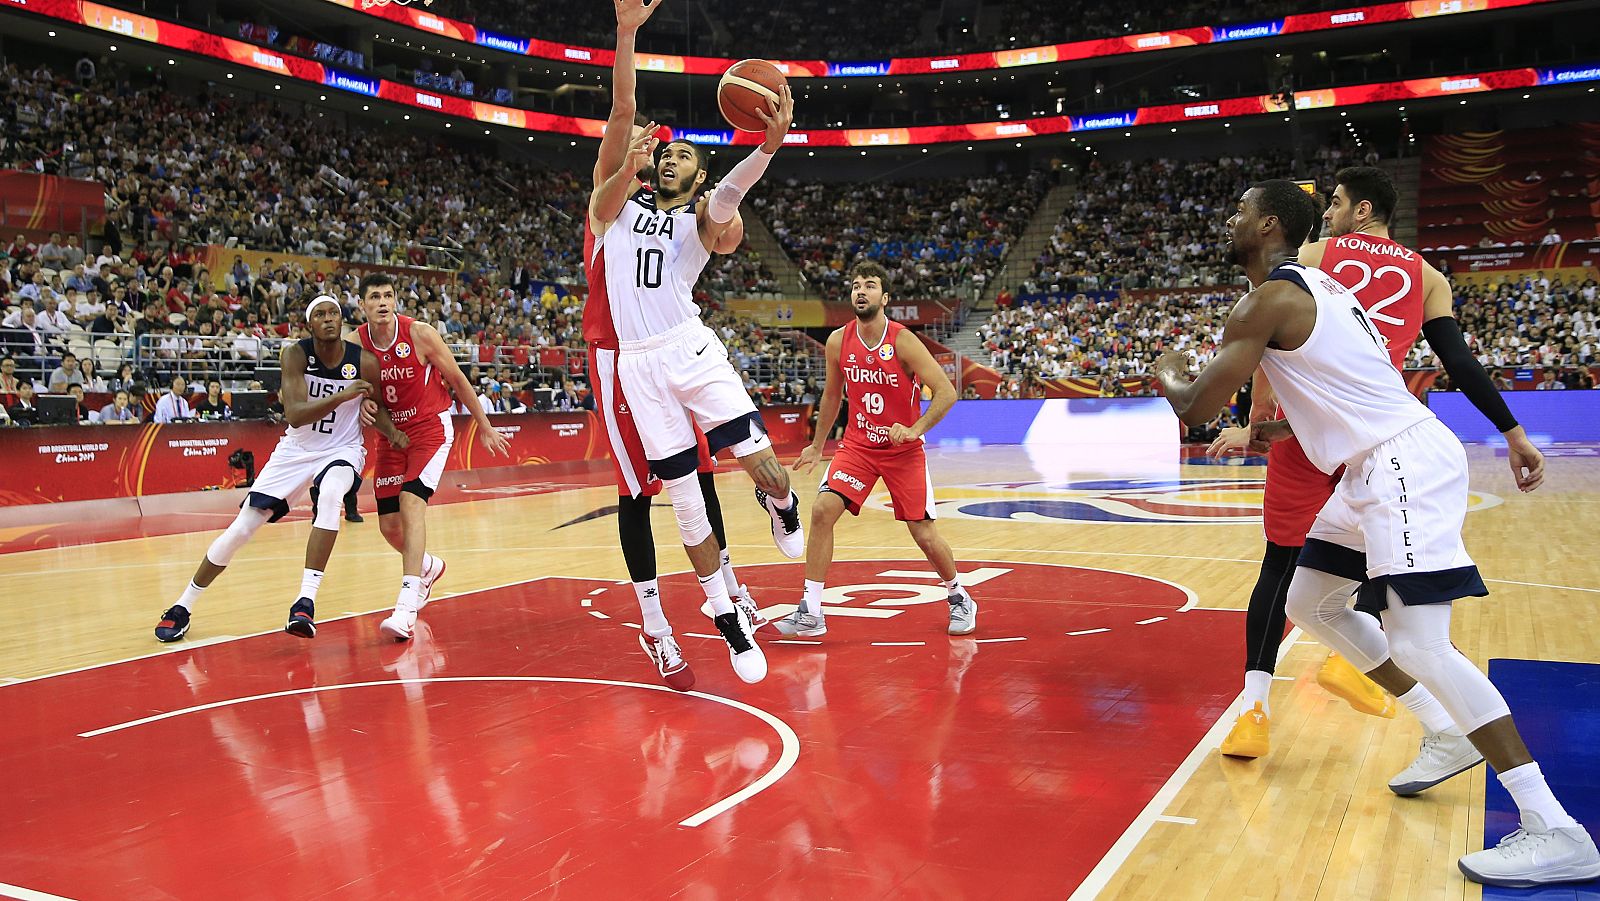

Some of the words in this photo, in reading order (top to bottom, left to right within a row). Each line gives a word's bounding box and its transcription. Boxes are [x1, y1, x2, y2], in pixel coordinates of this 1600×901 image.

[632, 212, 675, 241] USA
[1335, 237, 1415, 262] KORKMAZ
[636, 247, 664, 289] 10
[1332, 259, 1412, 326] 22
[381, 364, 415, 381] RKİYE
[843, 364, 899, 388] TÜRKİYE
[385, 385, 398, 403] 8
[861, 392, 885, 415] 19
[388, 406, 416, 419] aranti
[55, 453, 78, 464] China
[79, 452, 95, 462] 2019
[183, 447, 202, 457] China
[202, 446, 217, 456] 2019
